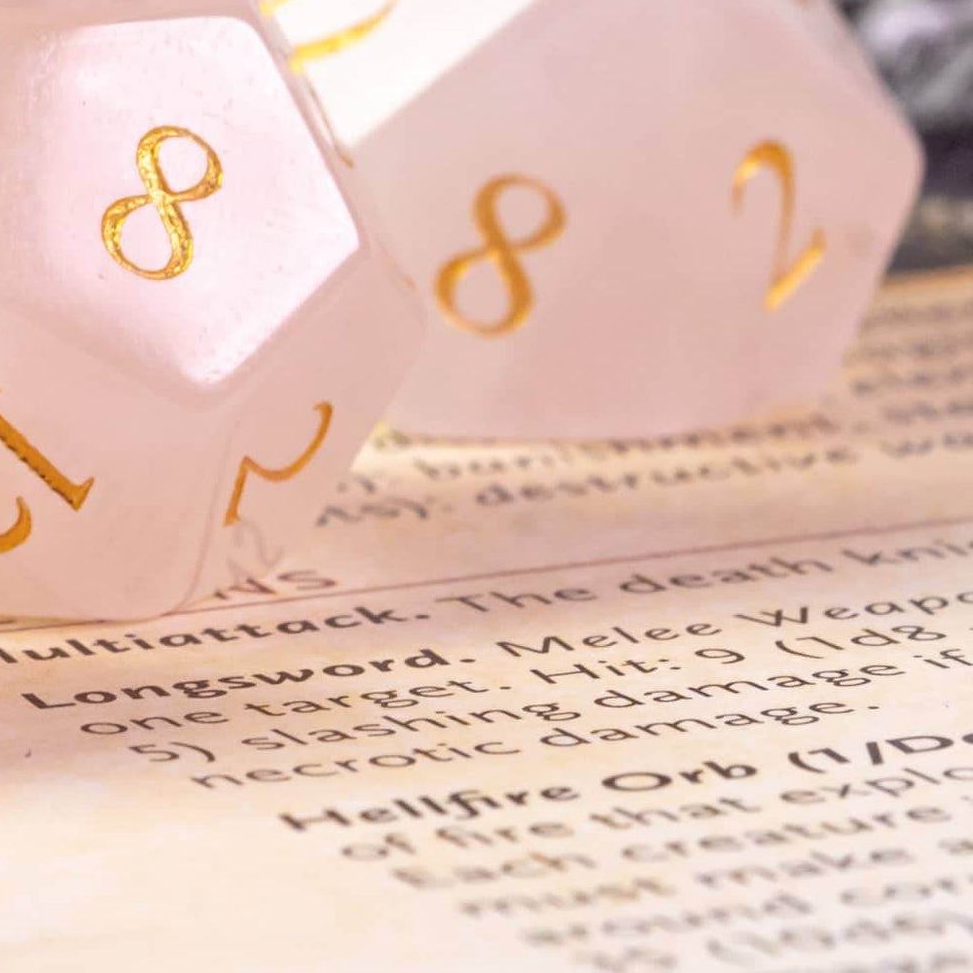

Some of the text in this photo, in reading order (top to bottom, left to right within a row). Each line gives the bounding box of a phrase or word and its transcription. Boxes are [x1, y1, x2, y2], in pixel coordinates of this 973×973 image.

[100, 124, 224, 281] 8
[730, 138, 826, 311] 2
[433, 172, 568, 338] 8
[223, 399, 334, 528] 2
[434, 586, 598, 613] The
[620, 556, 834, 594] death
[839, 538, 973, 566] kni
[21, 648, 476, 710] Longsword.
[496, 622, 723, 657] Melee
[80, 624, 947, 735] one target. Hit: 9 (1d8
[129, 648, 973, 763] 5) slashing damage if
[190, 701, 881, 790] necrotic damage.
[278, 785, 581, 831] Hellfire
[601, 759, 759, 793] Orb
[340, 832, 417, 862] of
[435, 822, 575, 849] fire
[589, 795, 762, 829] that
[391, 806, 952, 889] Each creature
[693, 846, 915, 888] make
